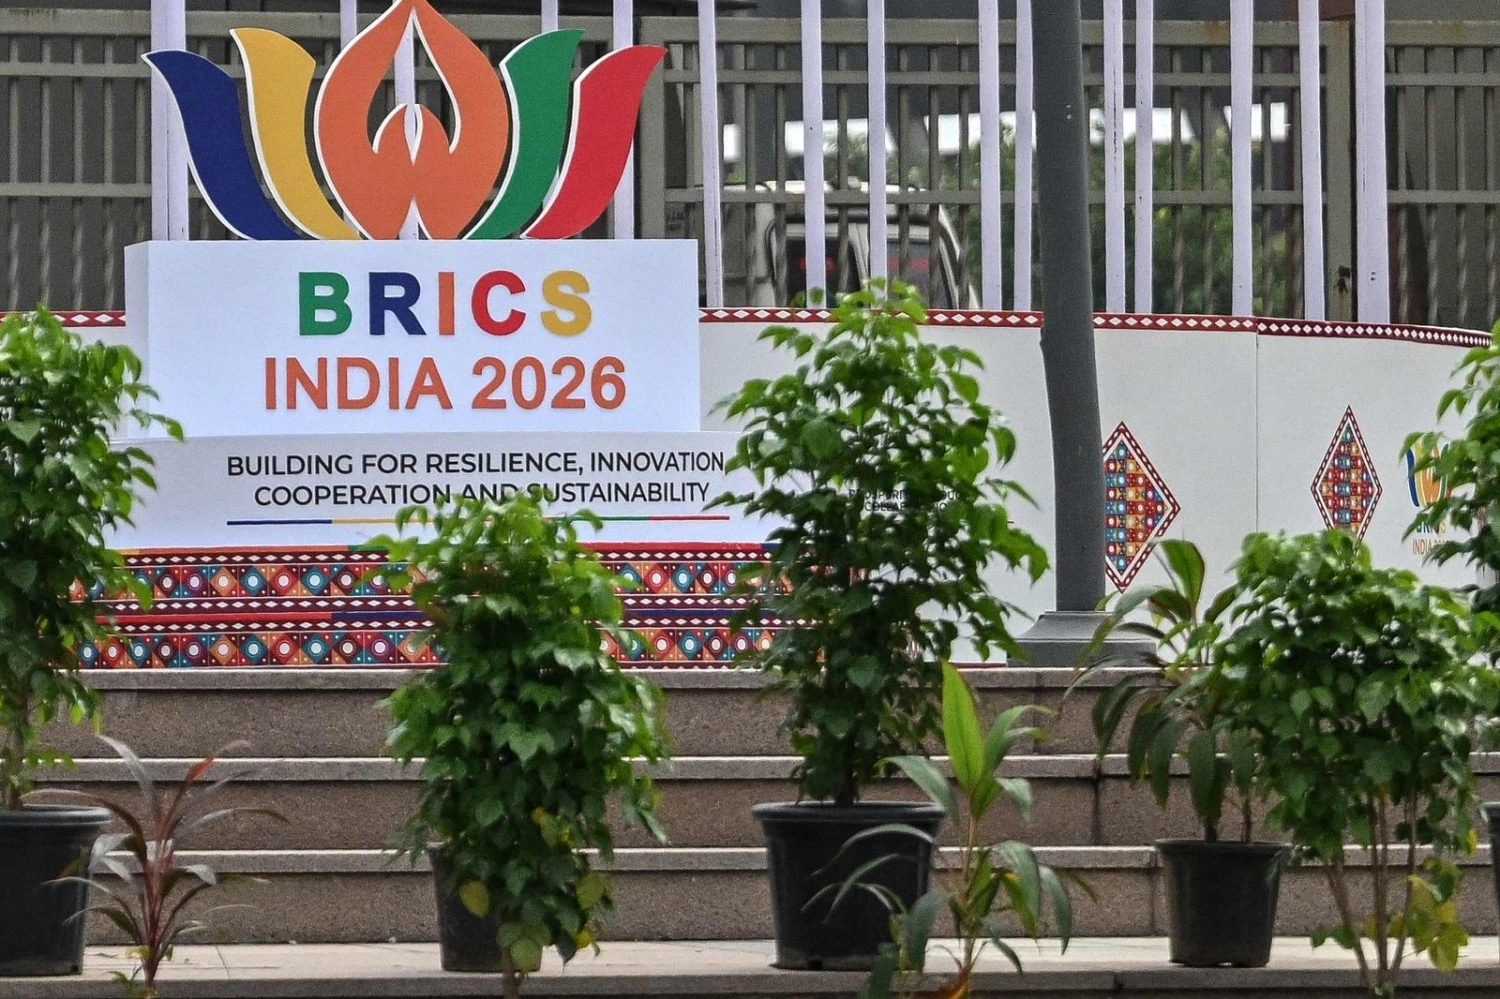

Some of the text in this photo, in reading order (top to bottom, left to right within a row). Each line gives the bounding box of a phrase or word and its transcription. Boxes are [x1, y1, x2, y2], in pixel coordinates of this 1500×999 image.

[298, 270, 592, 337] BRICS
[266, 355, 627, 410] INDIA 2026
[227, 451, 724, 477] BUILDING FOR RESILIENCE, INNOVATION
[254, 484, 451, 506] COOPERATION
